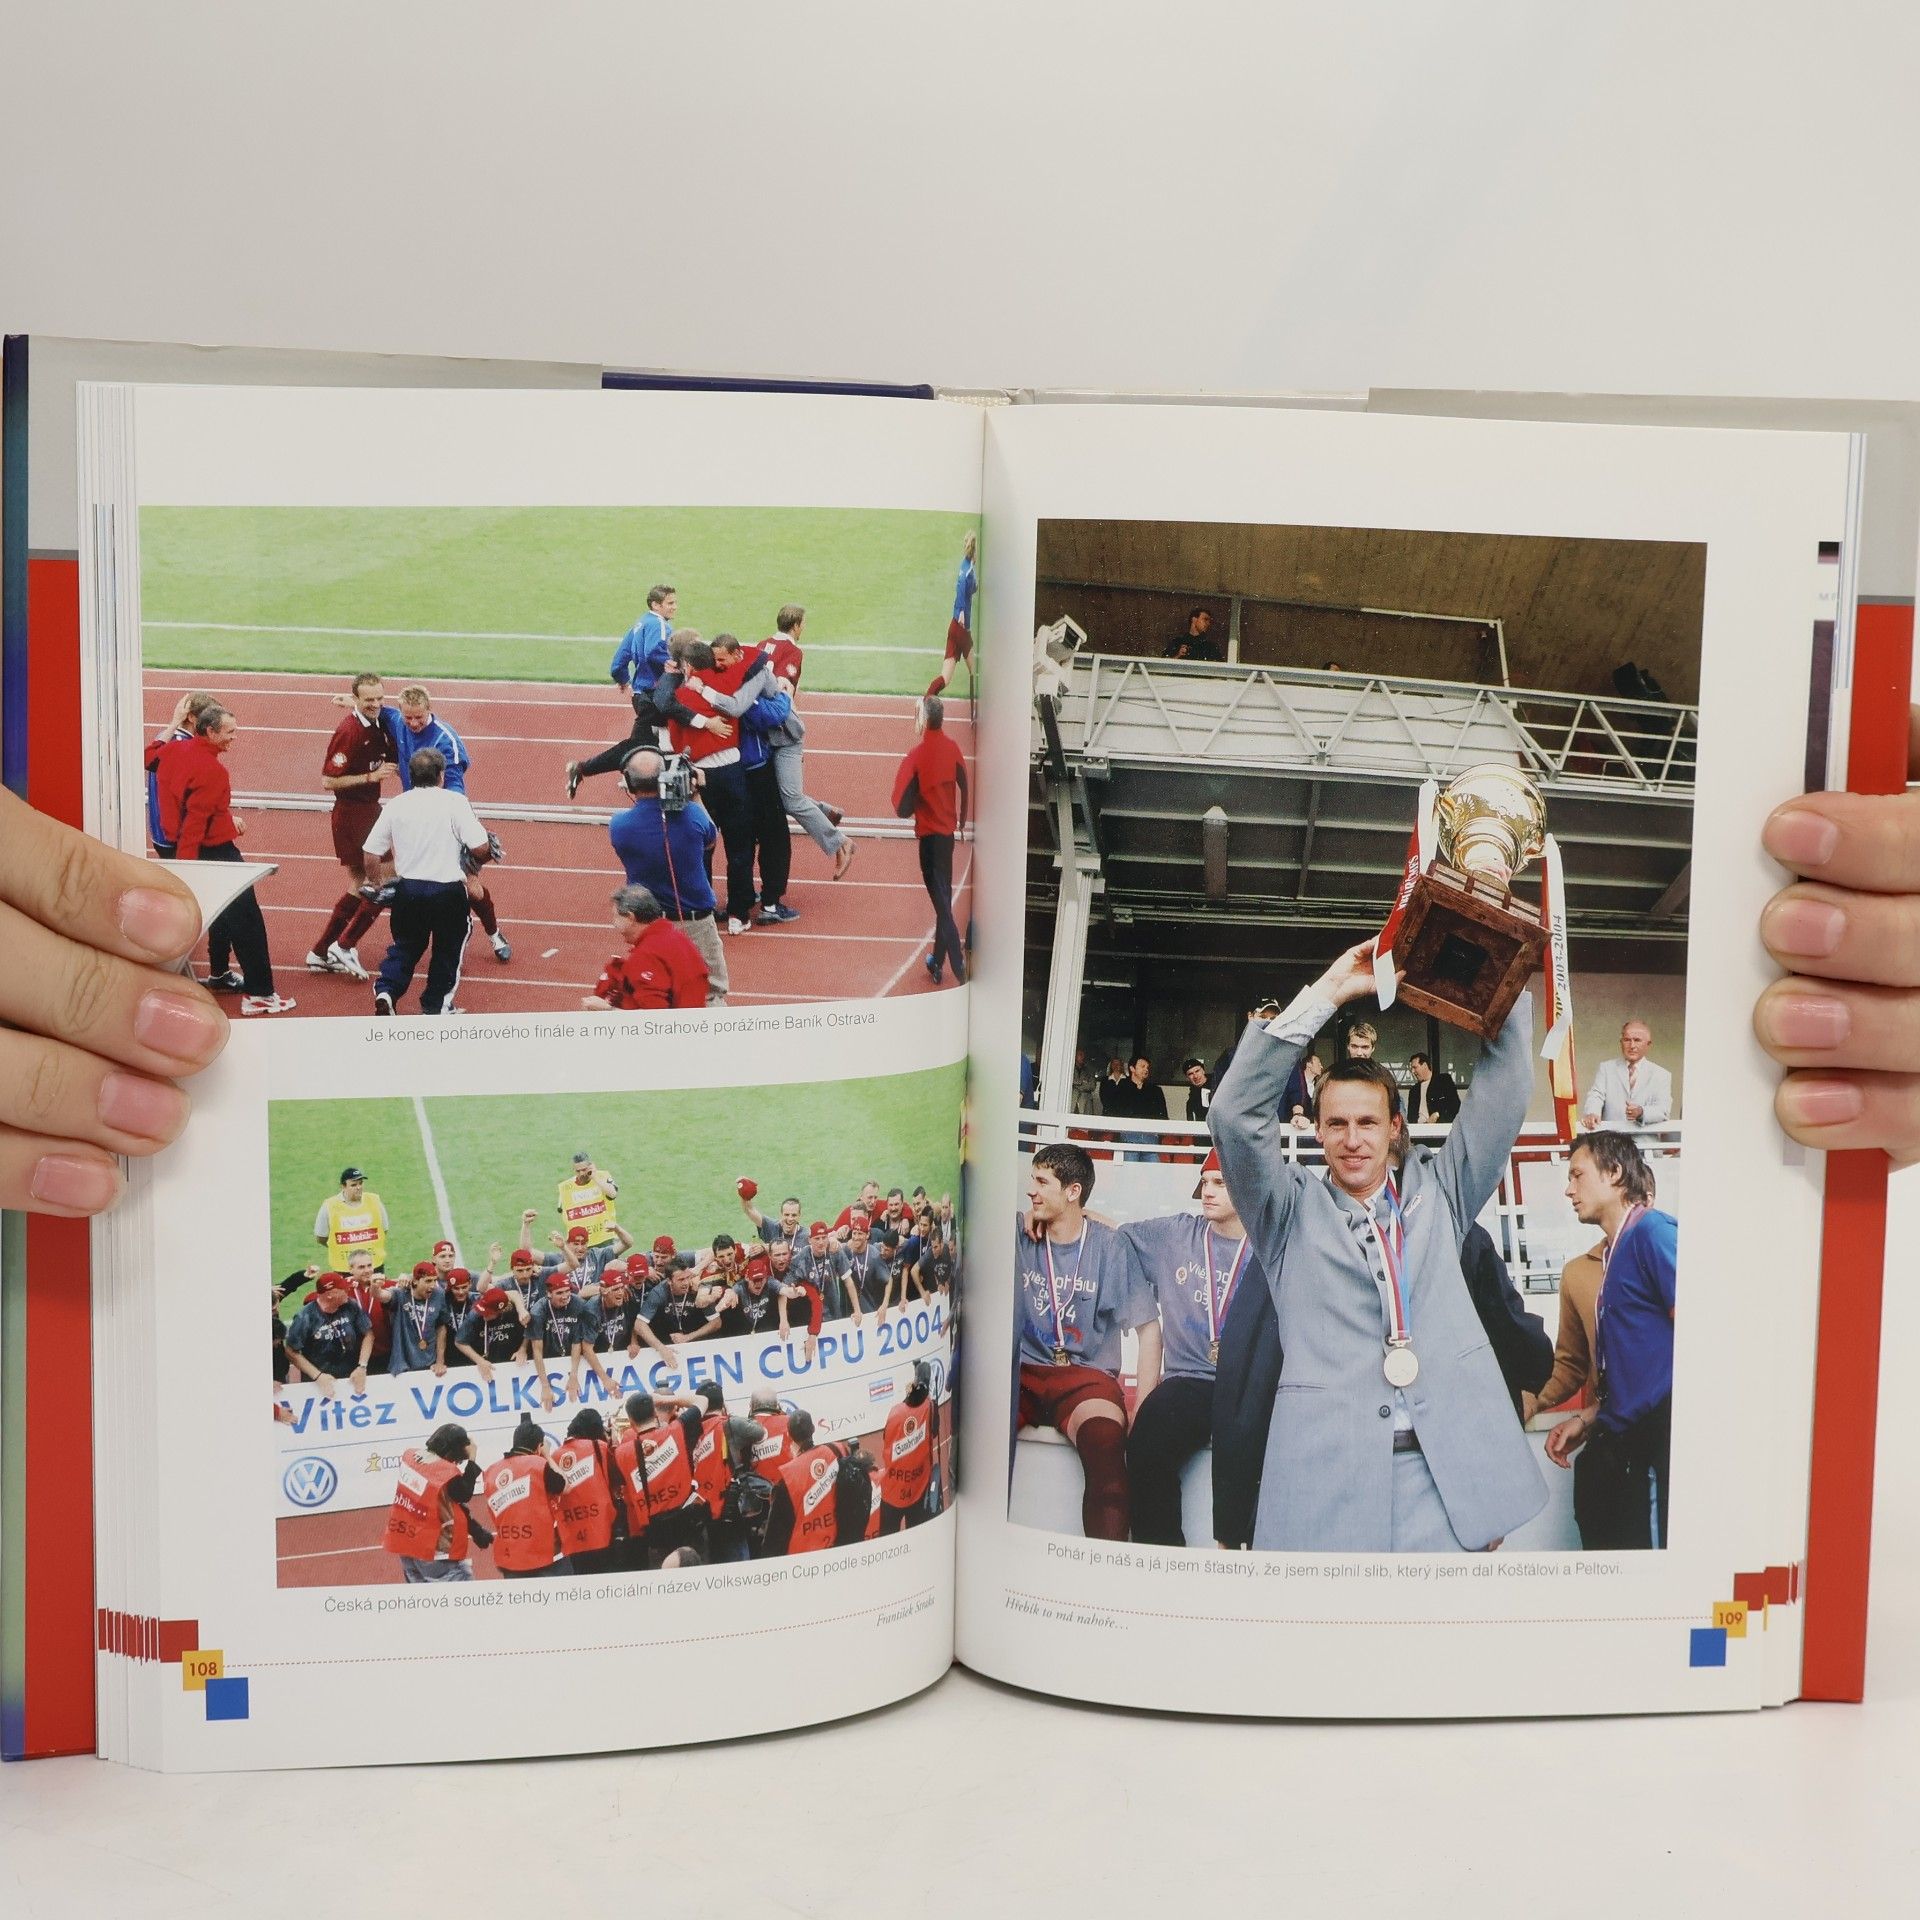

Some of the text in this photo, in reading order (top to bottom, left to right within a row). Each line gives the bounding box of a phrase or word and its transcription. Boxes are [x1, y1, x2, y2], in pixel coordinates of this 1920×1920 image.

[365, 1012, 878, 1043] Je konec pohárového finále a my na Strahově porážíme Baník Ostrava.
[280, 1304, 943, 1434] Vítěz VOLKSWAGEN CUPU 2004
[802, 1512, 834, 1536] PRE
[1047, 1542, 1623, 1580] Pohár je náš a já jsem šťastný, že jsem splnil slib, který jsem dal Košťálovi a Peltovi.
[324, 1542, 912, 1614] Česká pohárová soutěž tehdy měla oficiální název Volkswagen Cup podle sponzora.
[1005, 1595, 1040, 1617] Hřebík
[1042, 1606, 1053, 1619] to
[1056, 1609, 1074, 1623] má
[1719, 1611, 1743, 1626] 109
[189, 1661, 218, 1677] 108
